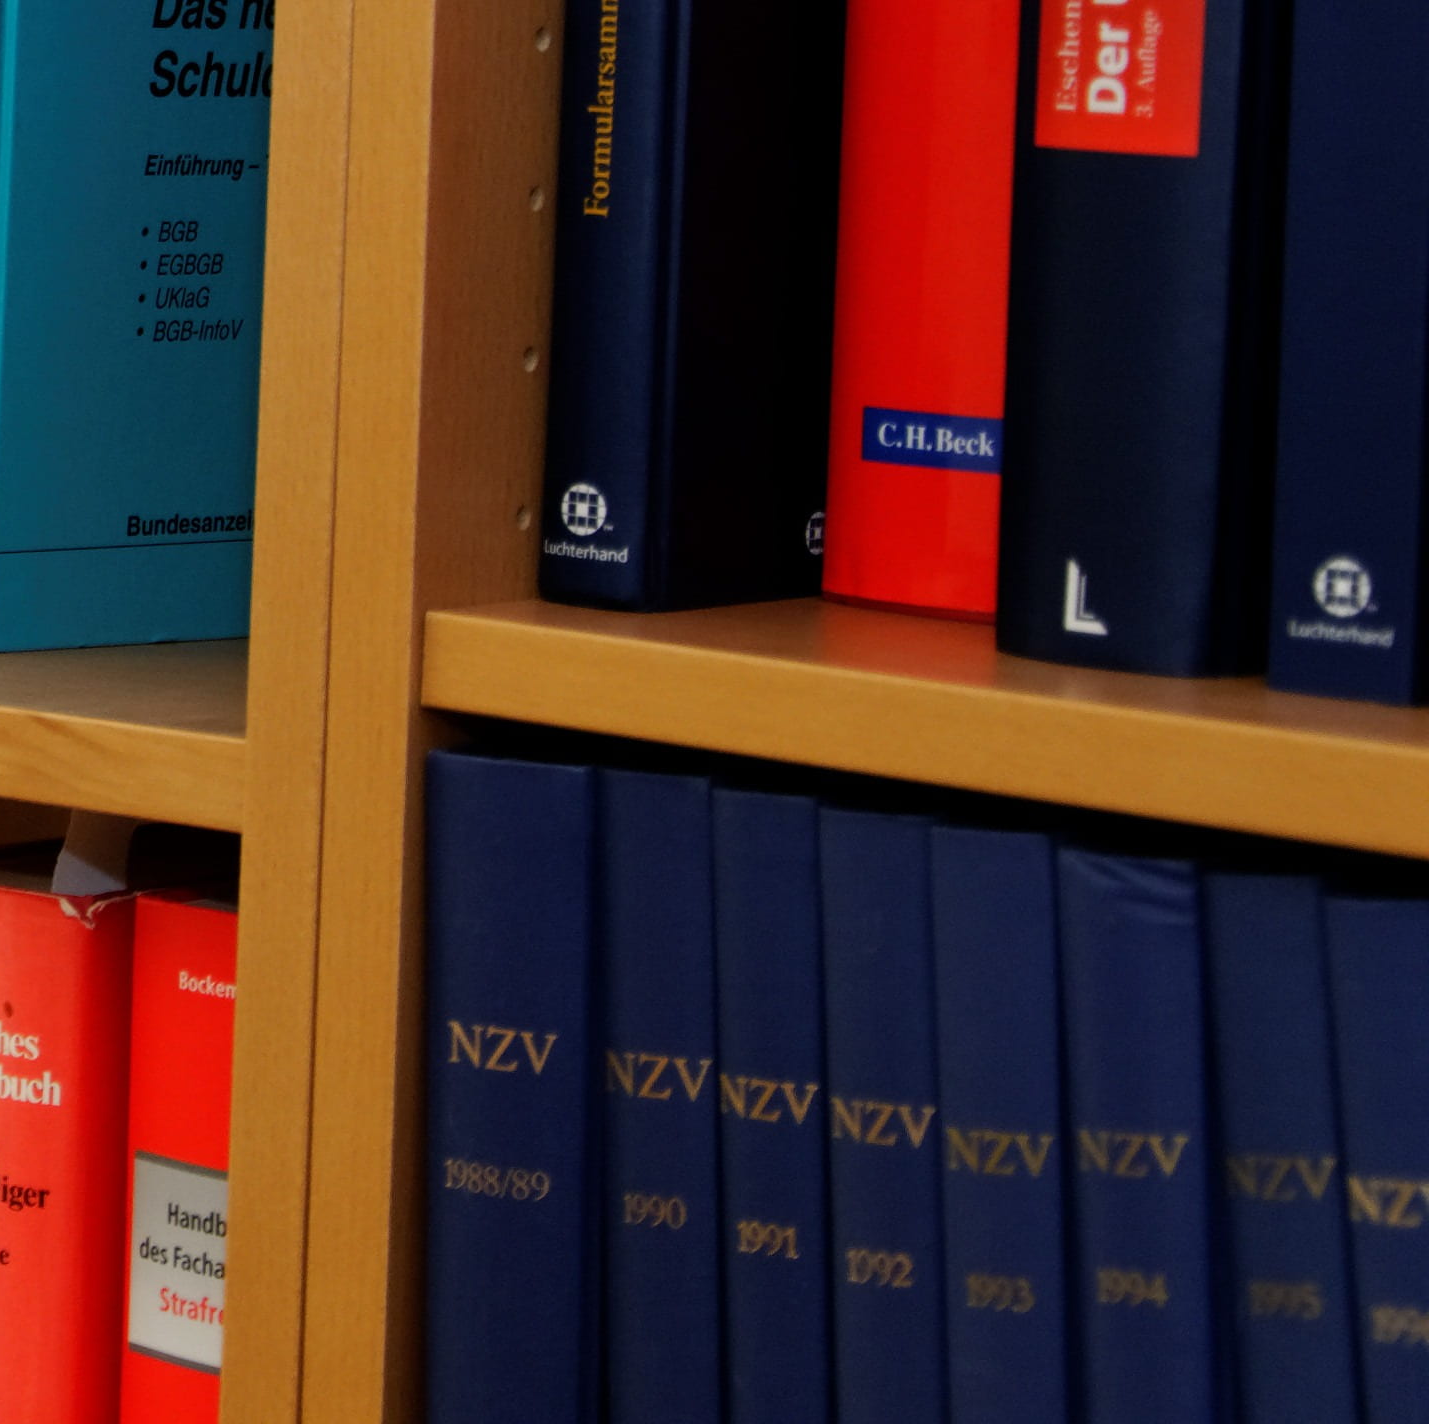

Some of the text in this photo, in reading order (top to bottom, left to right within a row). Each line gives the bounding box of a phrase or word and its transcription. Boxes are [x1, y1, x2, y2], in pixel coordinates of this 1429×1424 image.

[1085, 22, 1129, 117] Der
[144, 153, 244, 181] Einführung
[158, 220, 199, 242] BGB
[156, 253, 224, 276] EGBGB
[155, 286, 210, 309] UKlaG
[153, 319, 243, 343] BGB-InfoV
[877, 420, 995, 460] C.H.Beck
[544, 538, 629, 566] Luchterhand
[447, 1020, 559, 1075] NZV
[605, 1049, 713, 1103] NZV
[719, 1072, 819, 1126] NZV
[830, 1096, 941, 1149] NZV
[946, 1127, 1054, 1178] NZV
[1077, 1128, 1189, 1179] NZV
[139, 1237, 169, 1267] des
